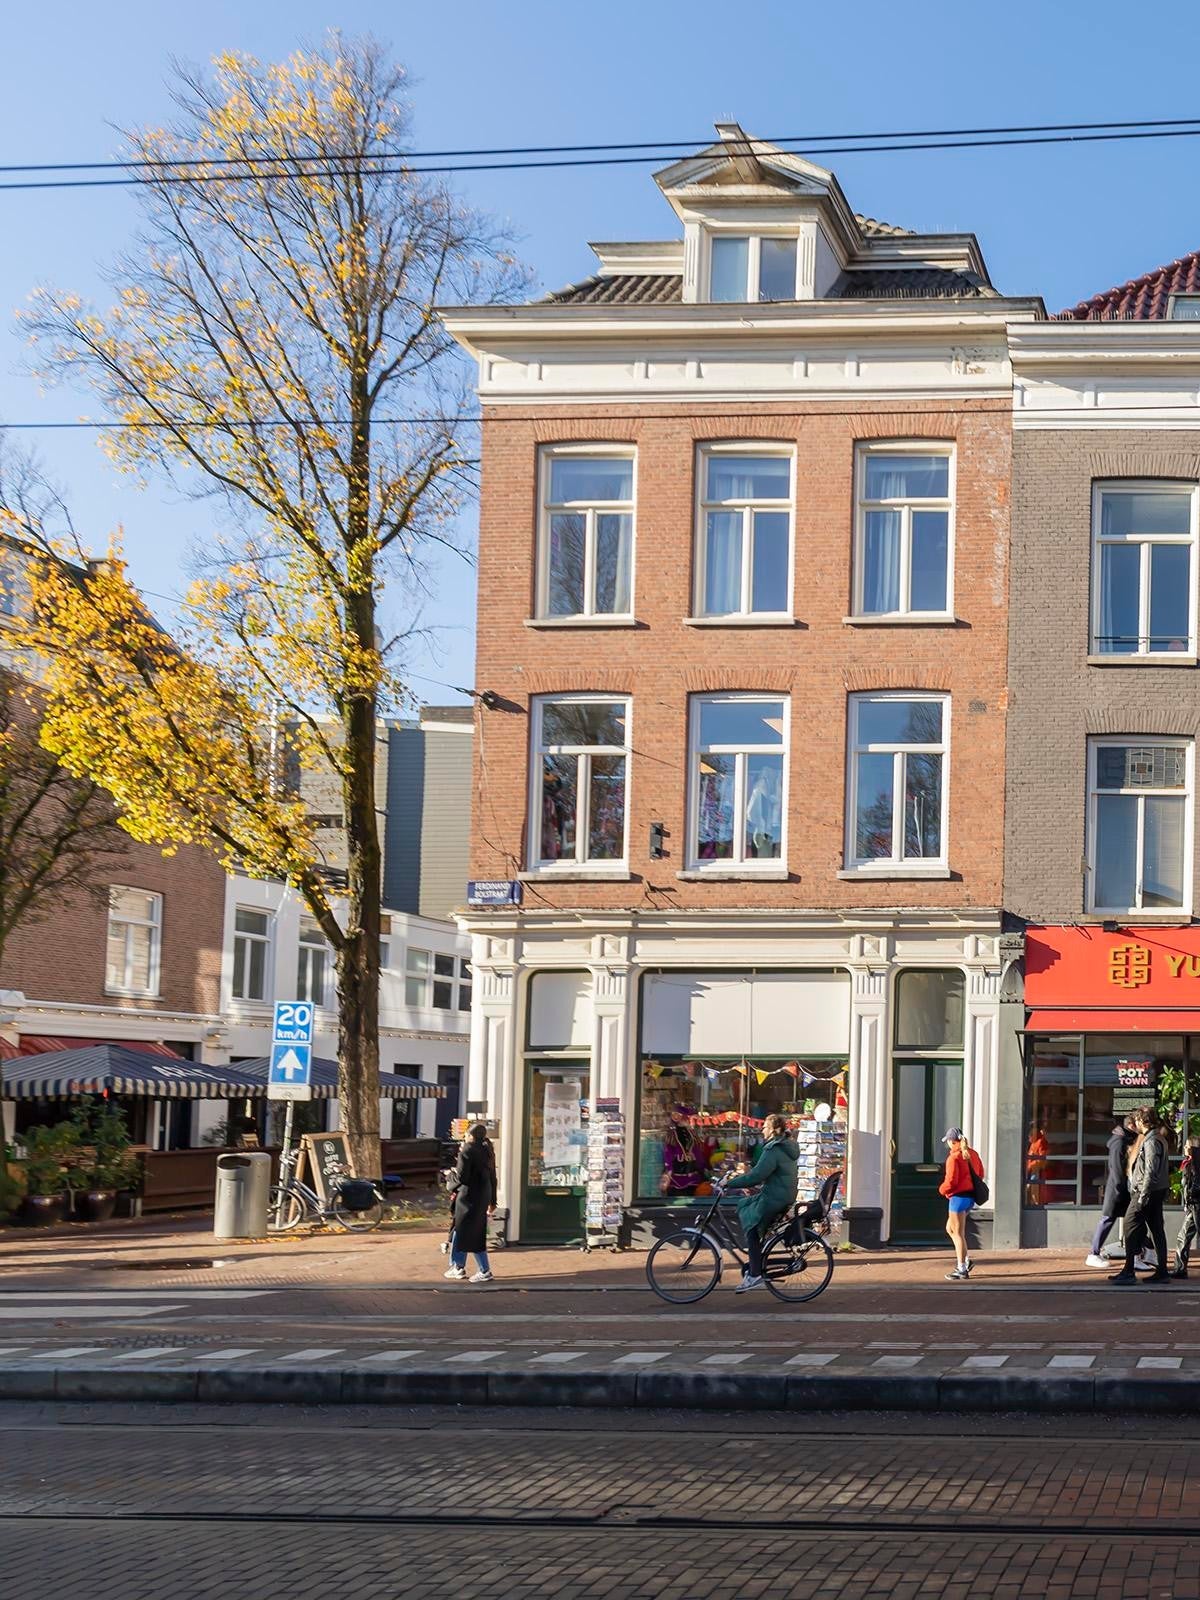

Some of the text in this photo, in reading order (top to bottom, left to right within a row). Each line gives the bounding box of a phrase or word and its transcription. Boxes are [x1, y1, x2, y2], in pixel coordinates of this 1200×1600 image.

[475, 882, 511, 890] FERDINAND
[475, 890, 509, 898] BOLSTRAAT
[278, 1005, 311, 1027] 20
[277, 1028, 308, 1040] km/h
[1118, 1068, 1144, 1077] POT
